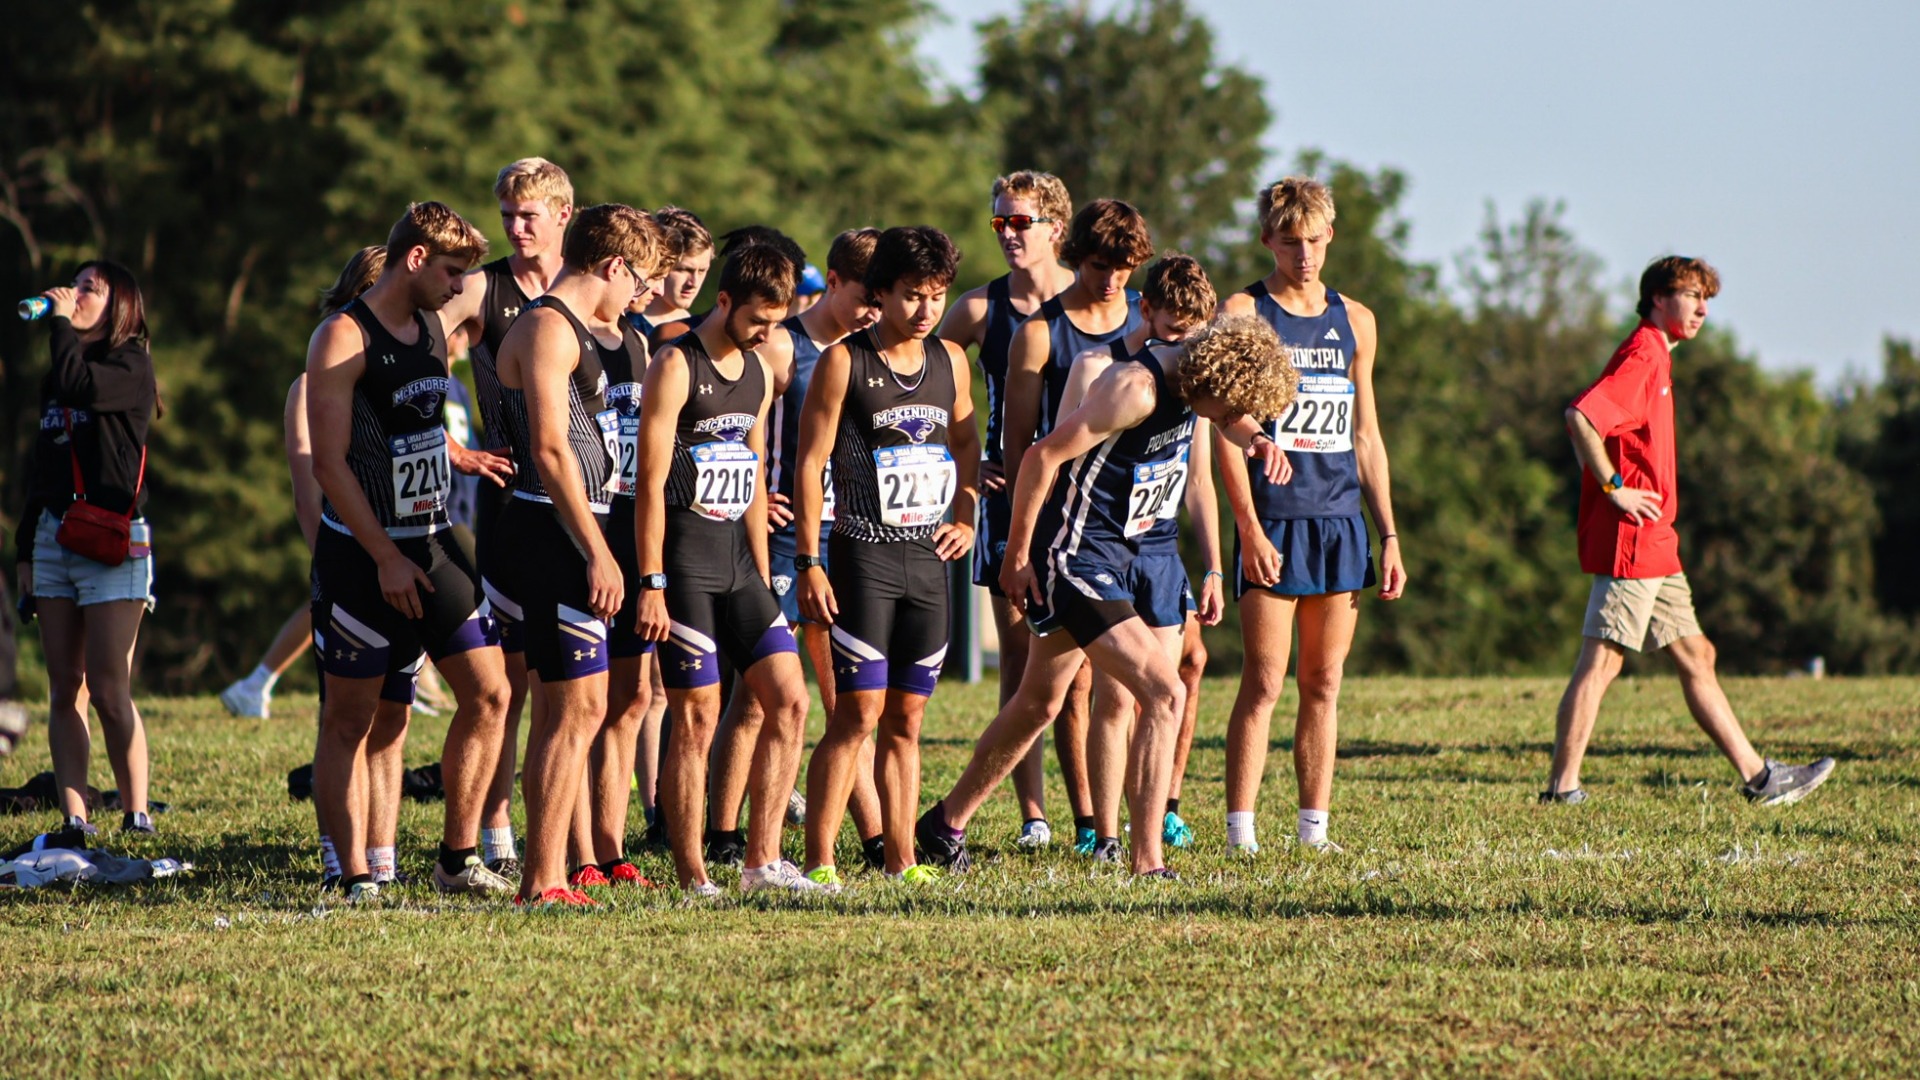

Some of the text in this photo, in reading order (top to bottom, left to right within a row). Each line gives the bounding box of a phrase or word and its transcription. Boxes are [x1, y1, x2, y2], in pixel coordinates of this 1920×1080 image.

[873, 404, 948, 429] McKENDREE
[1280, 400, 1349, 435] 2228
[1292, 438, 1336, 451] MileSplit
[399, 452, 449, 499] 2214
[700, 468, 753, 504] 2216
